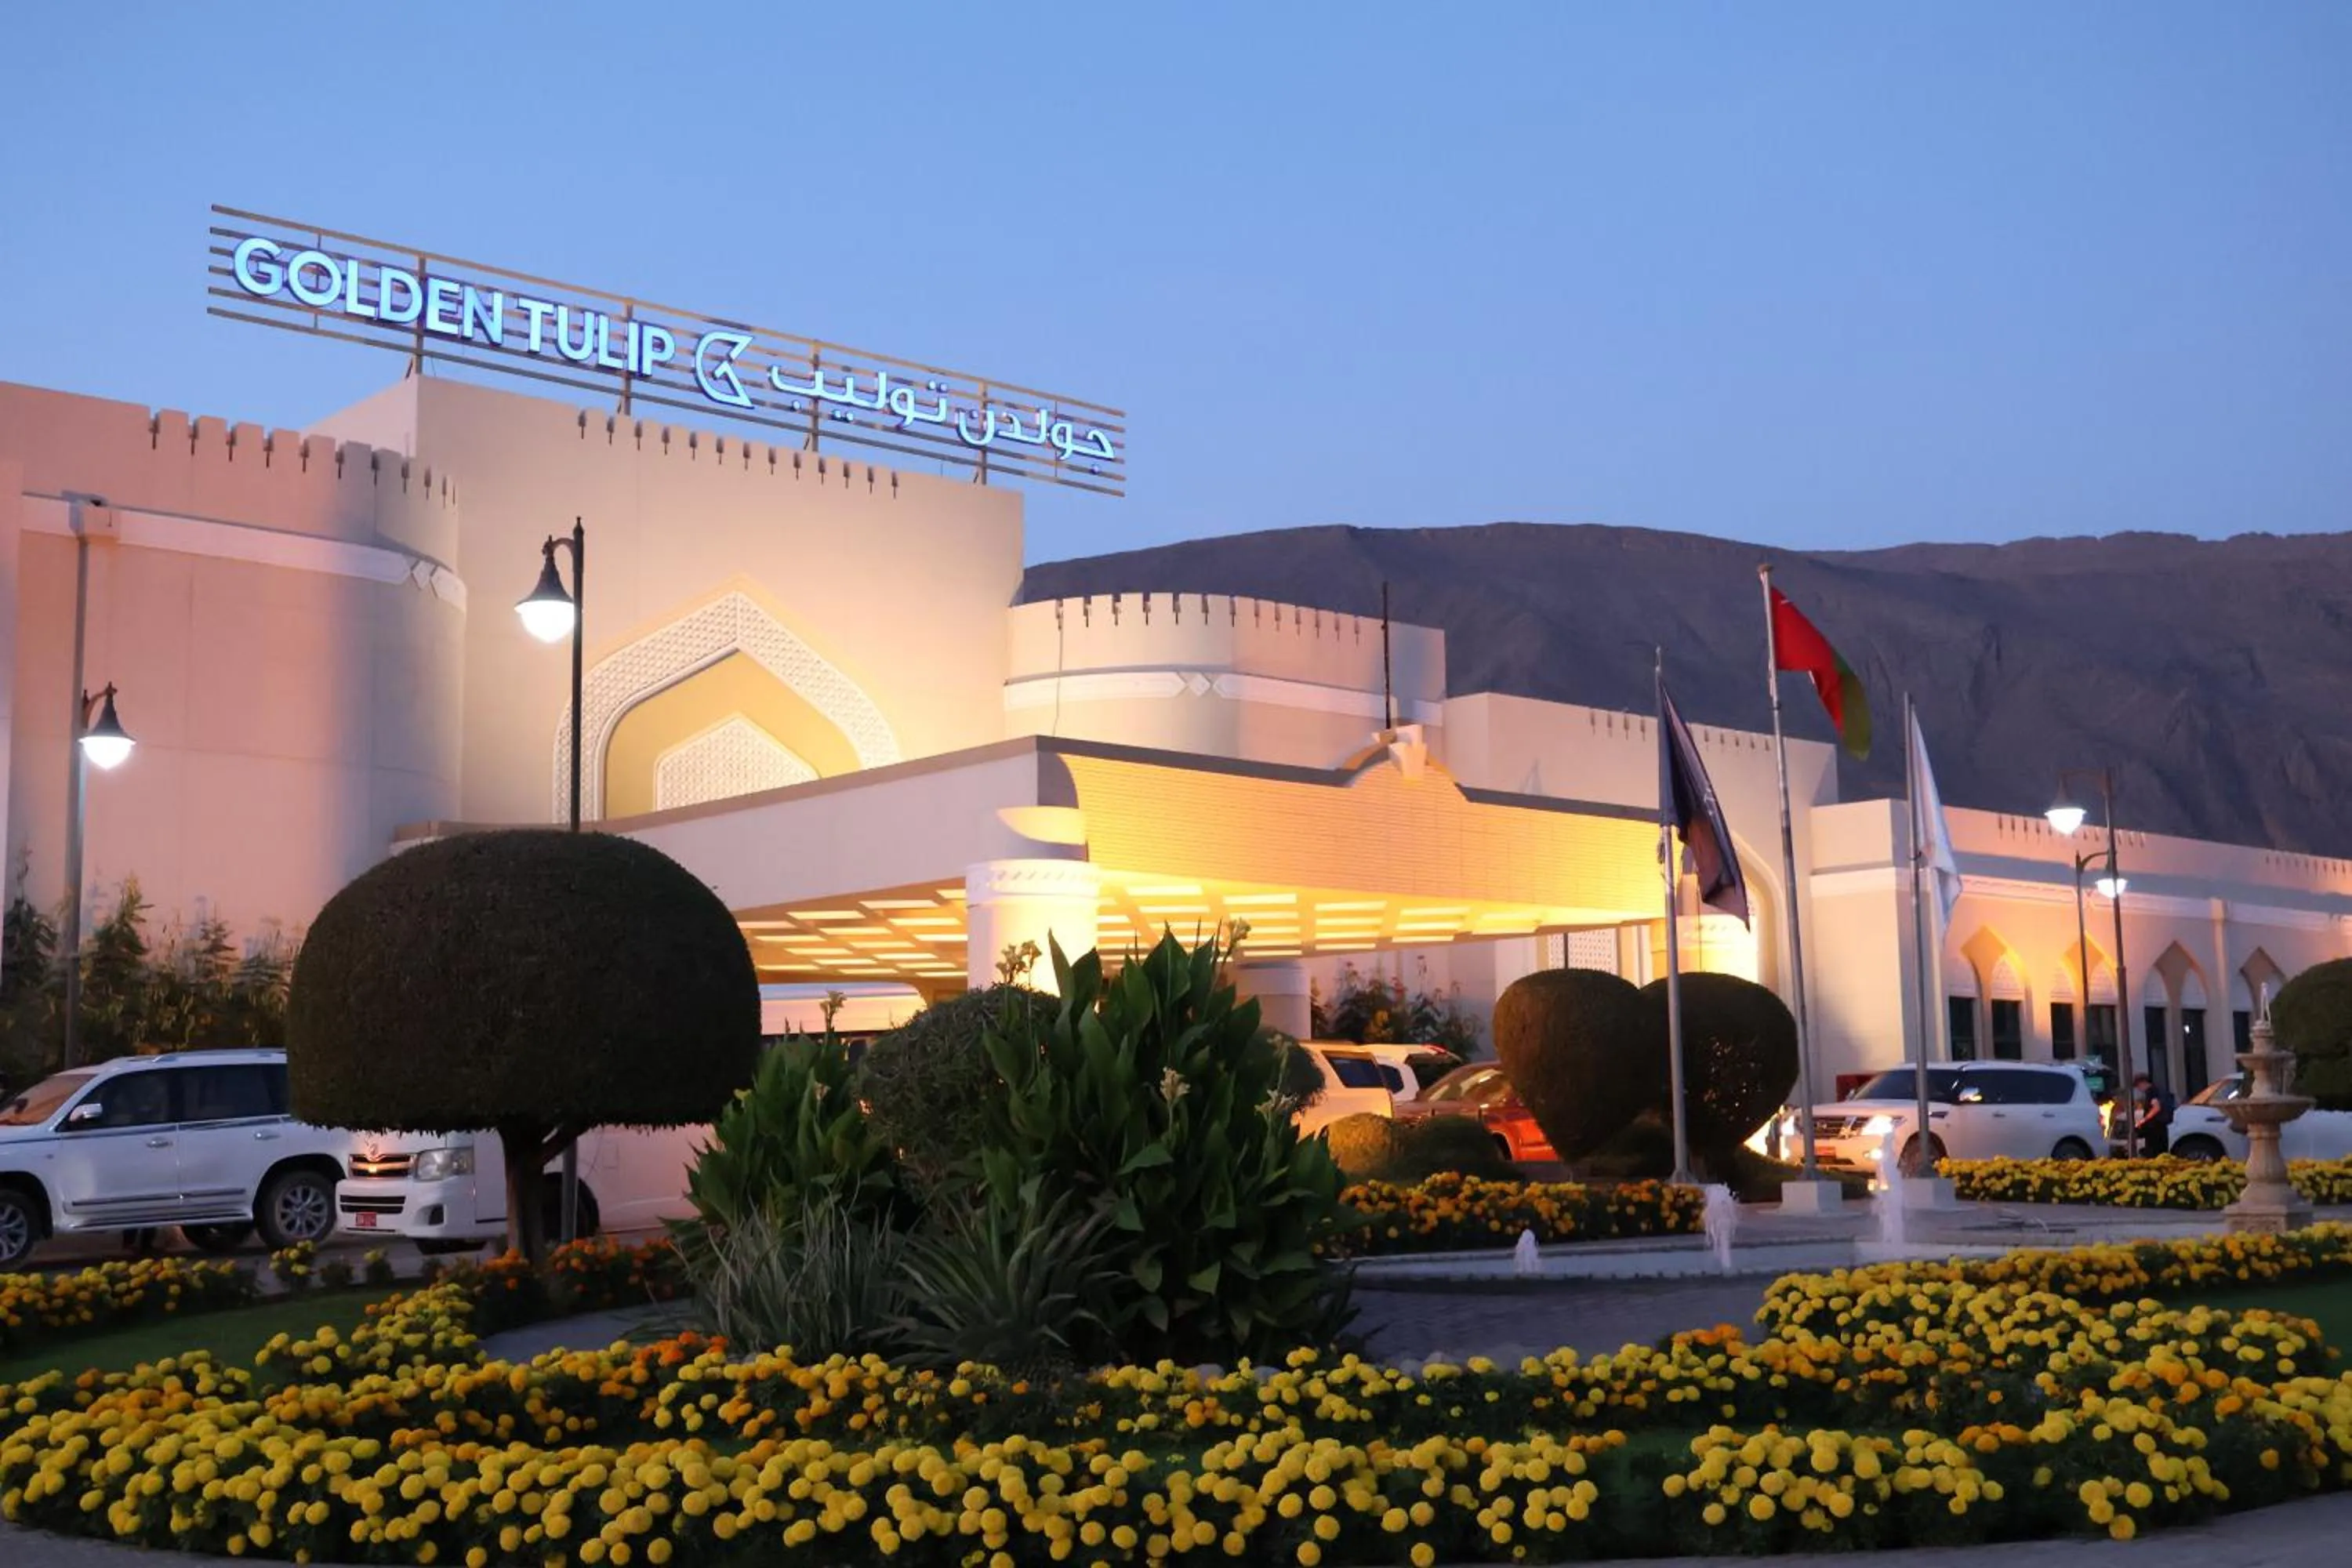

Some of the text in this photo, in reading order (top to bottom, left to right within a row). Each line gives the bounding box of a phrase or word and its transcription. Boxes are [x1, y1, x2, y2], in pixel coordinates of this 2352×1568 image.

[233, 237, 677, 376] GOLDEN TULIP
[769, 365, 1116, 474] جولدن توليب
